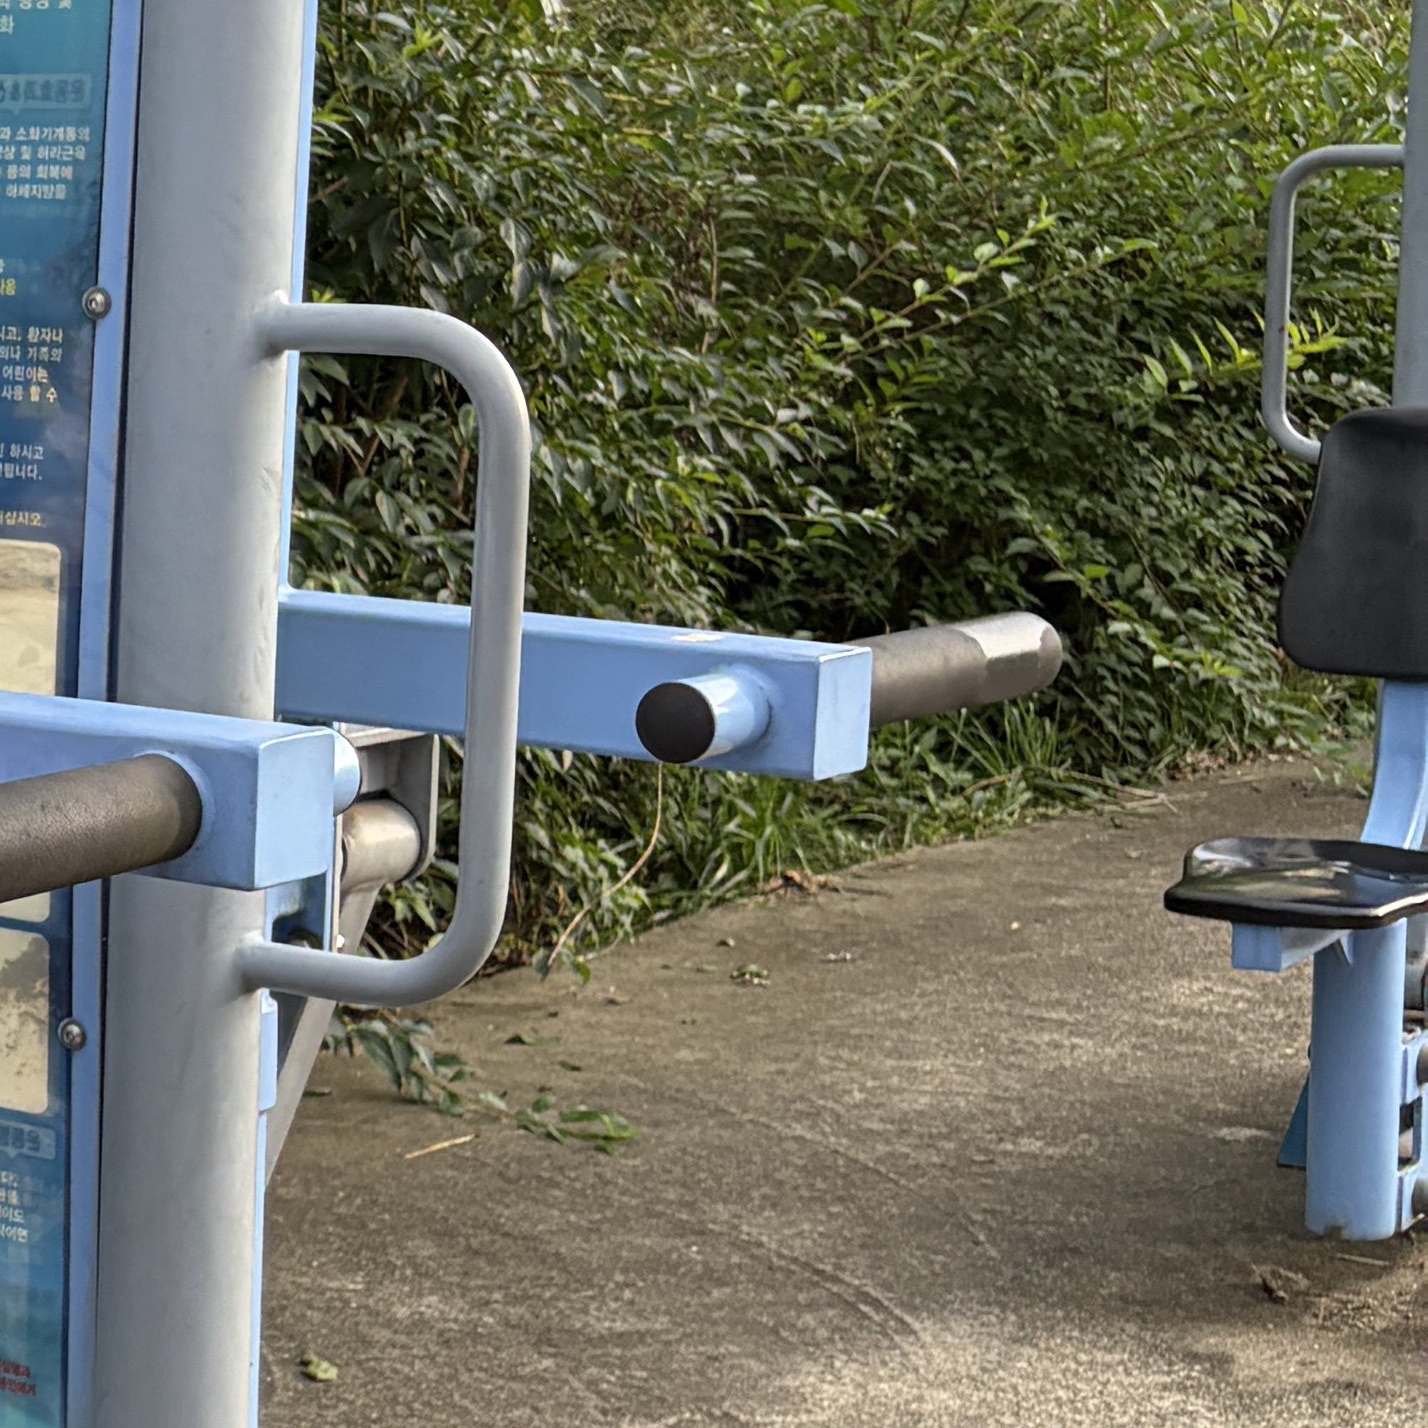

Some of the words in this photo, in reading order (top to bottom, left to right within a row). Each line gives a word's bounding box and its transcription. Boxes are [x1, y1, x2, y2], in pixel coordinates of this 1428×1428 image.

[1, 384, 24, 402] 사용
[45, 386, 59, 403] 수
[9, 443, 44, 461] 하시고
